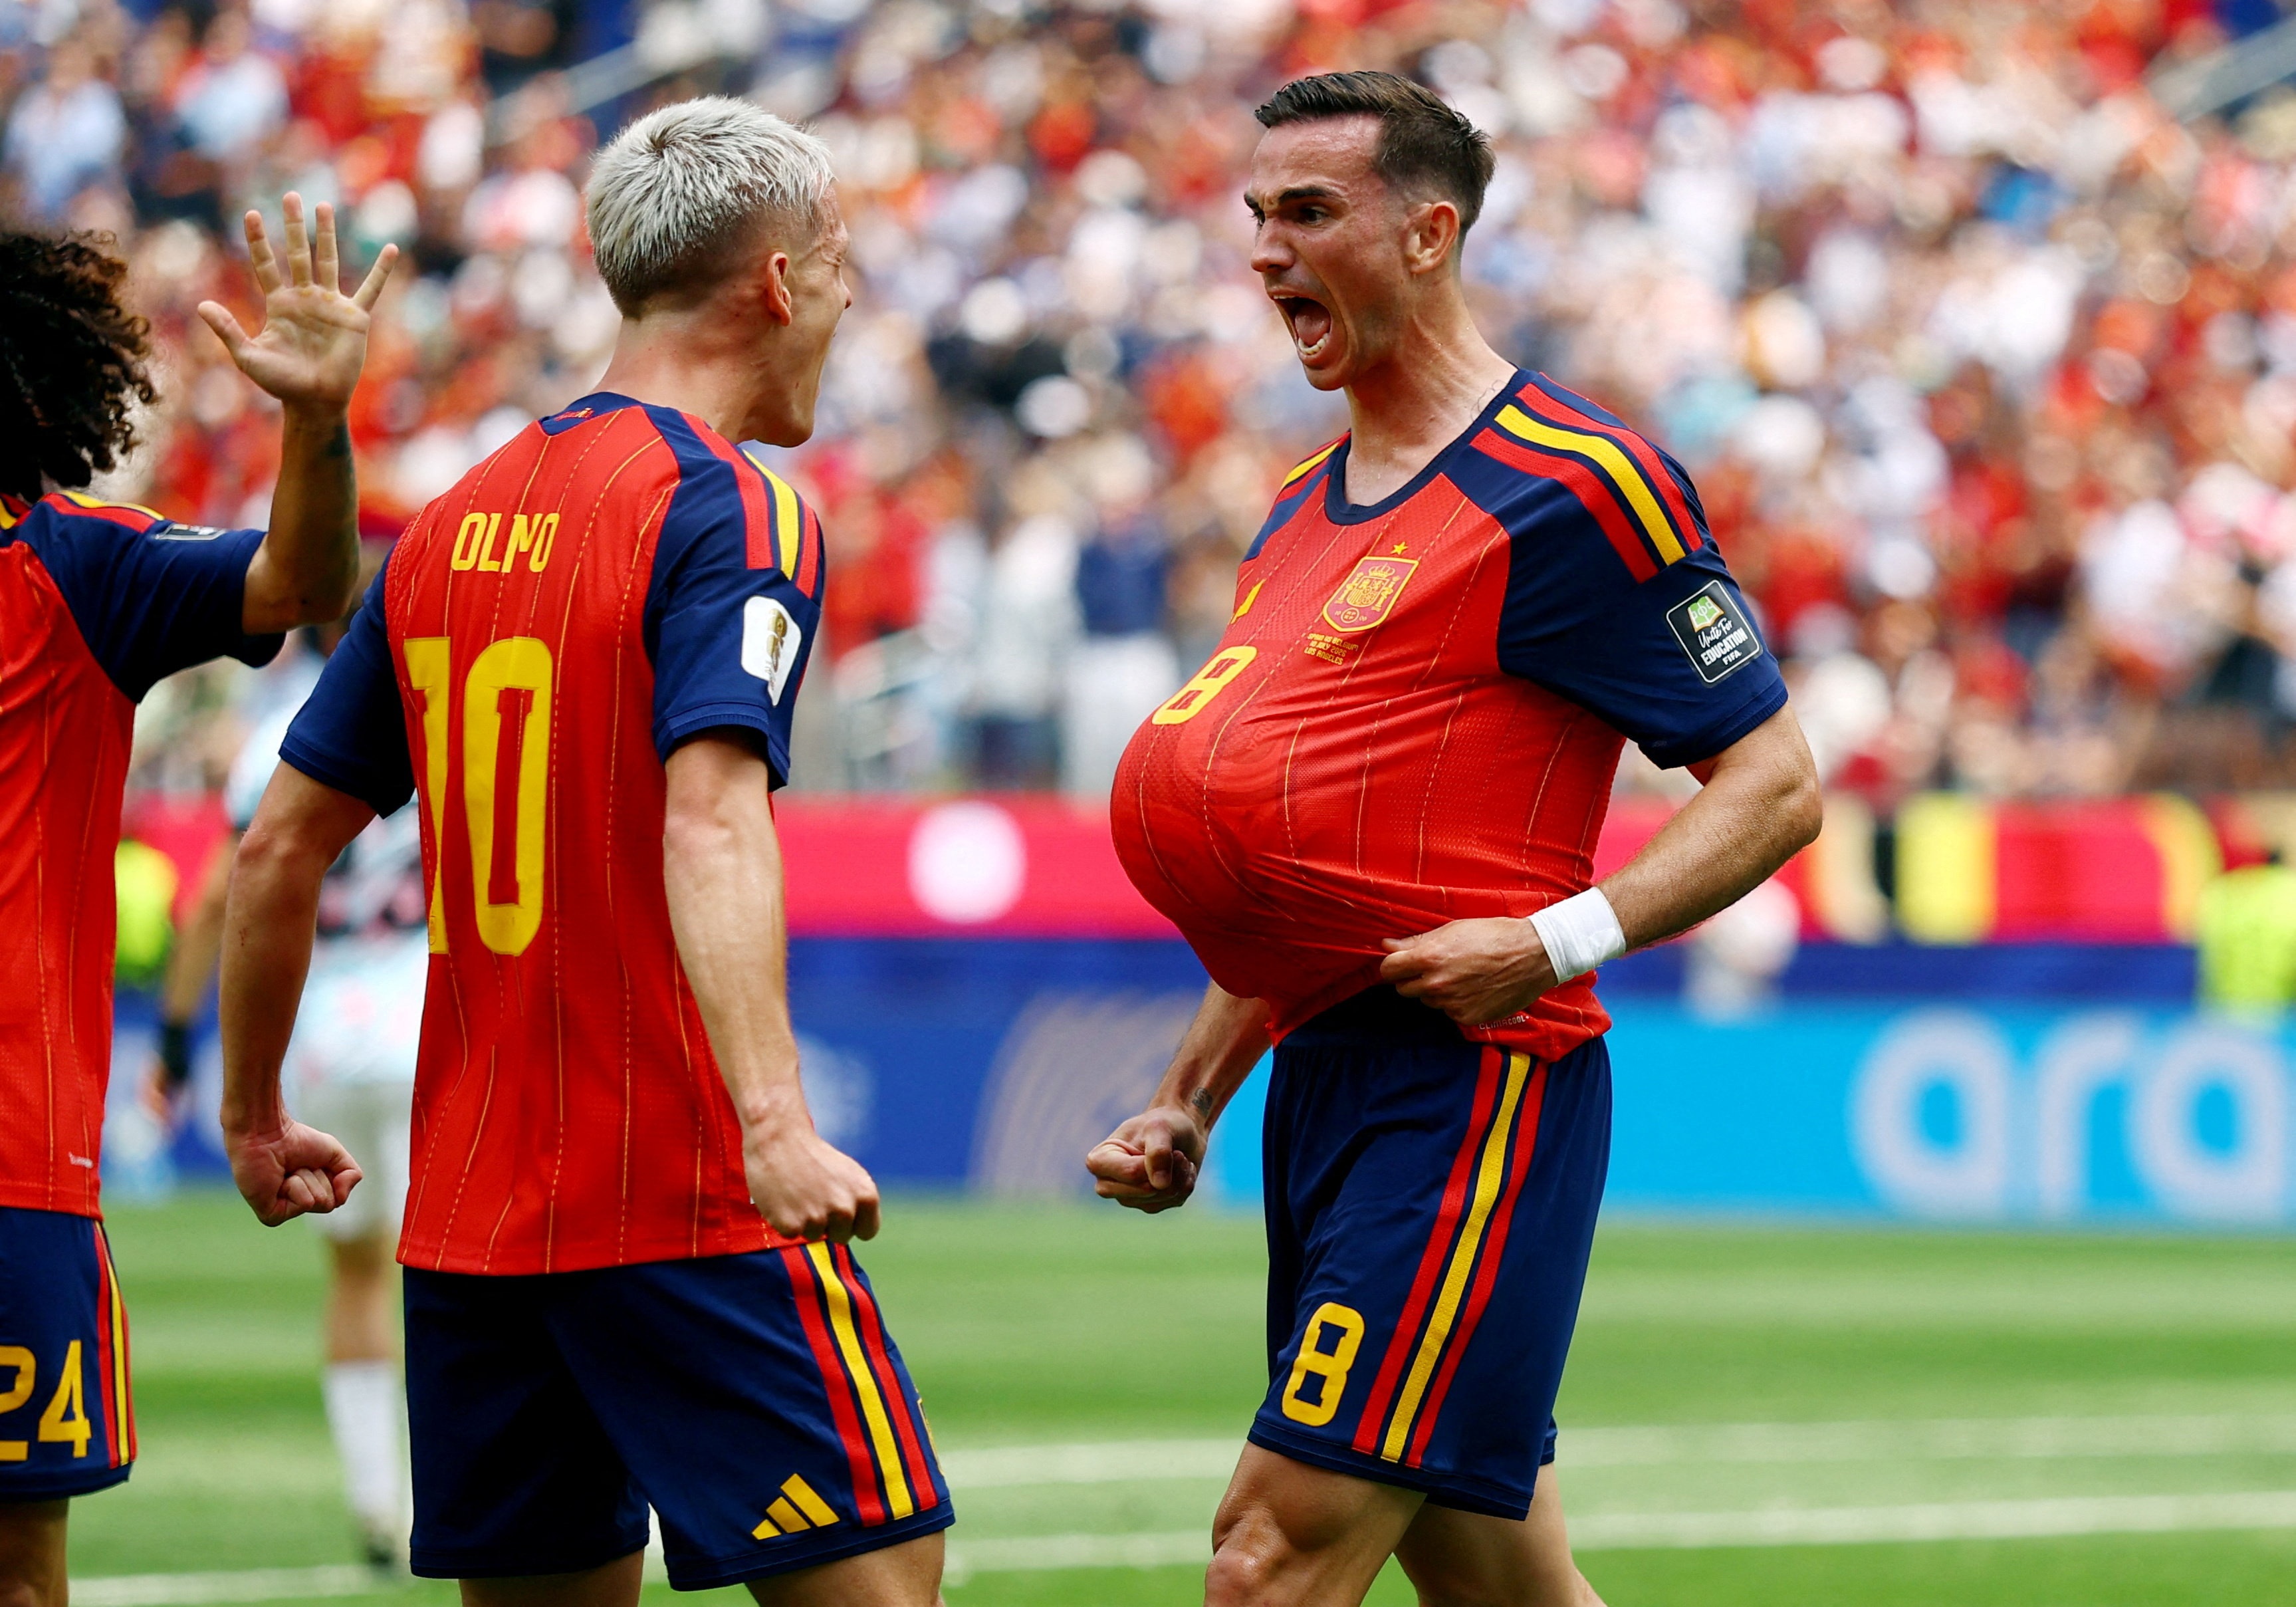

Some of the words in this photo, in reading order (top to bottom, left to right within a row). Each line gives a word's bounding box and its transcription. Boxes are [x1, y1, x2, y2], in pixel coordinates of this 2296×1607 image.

[451, 512, 560, 573] OLMO
[1304, 647, 1317, 656] LOS
[1316, 650, 1343, 665] ANGELES
[1698, 627, 1722, 648] Unite
[1718, 618, 1733, 635] For
[1700, 628, 1748, 666] EDUCATION
[1722, 650, 1742, 666] FIFA
[1152, 646, 1257, 725] 8
[403, 636, 552, 957] 10
[1282, 1302, 1364, 1426] 8
[0, 1339, 92, 1461] 24
